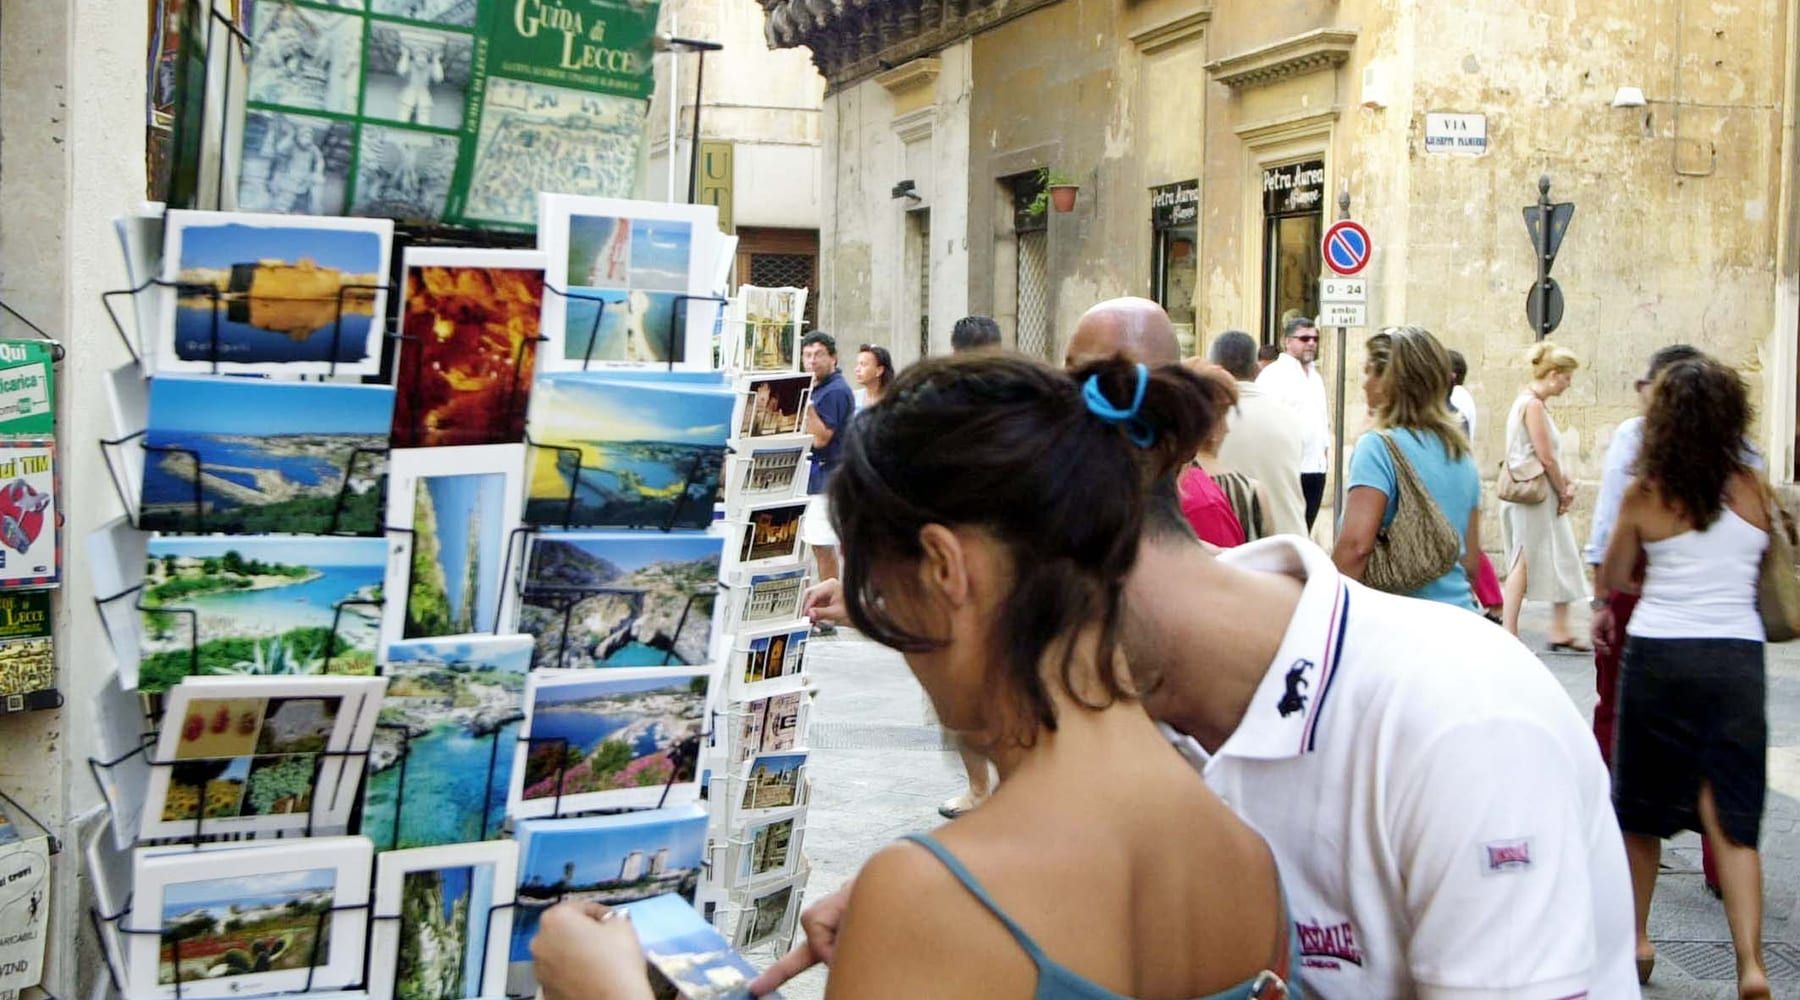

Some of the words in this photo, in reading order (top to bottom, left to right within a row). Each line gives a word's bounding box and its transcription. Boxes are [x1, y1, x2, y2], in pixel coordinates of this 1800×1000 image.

[1444, 119, 1467, 130] VIA
[1264, 169, 1291, 192] Petra
[1292, 164, 1323, 188] Aurea
[1152, 188, 1174, 208] Petra
[1326, 284, 1335, 294] 0
[1346, 284, 1362, 295] 24
[1331, 306, 1357, 314] ambo
[0, 342, 27, 362] Qui
[19, 454, 49, 475] TIM
